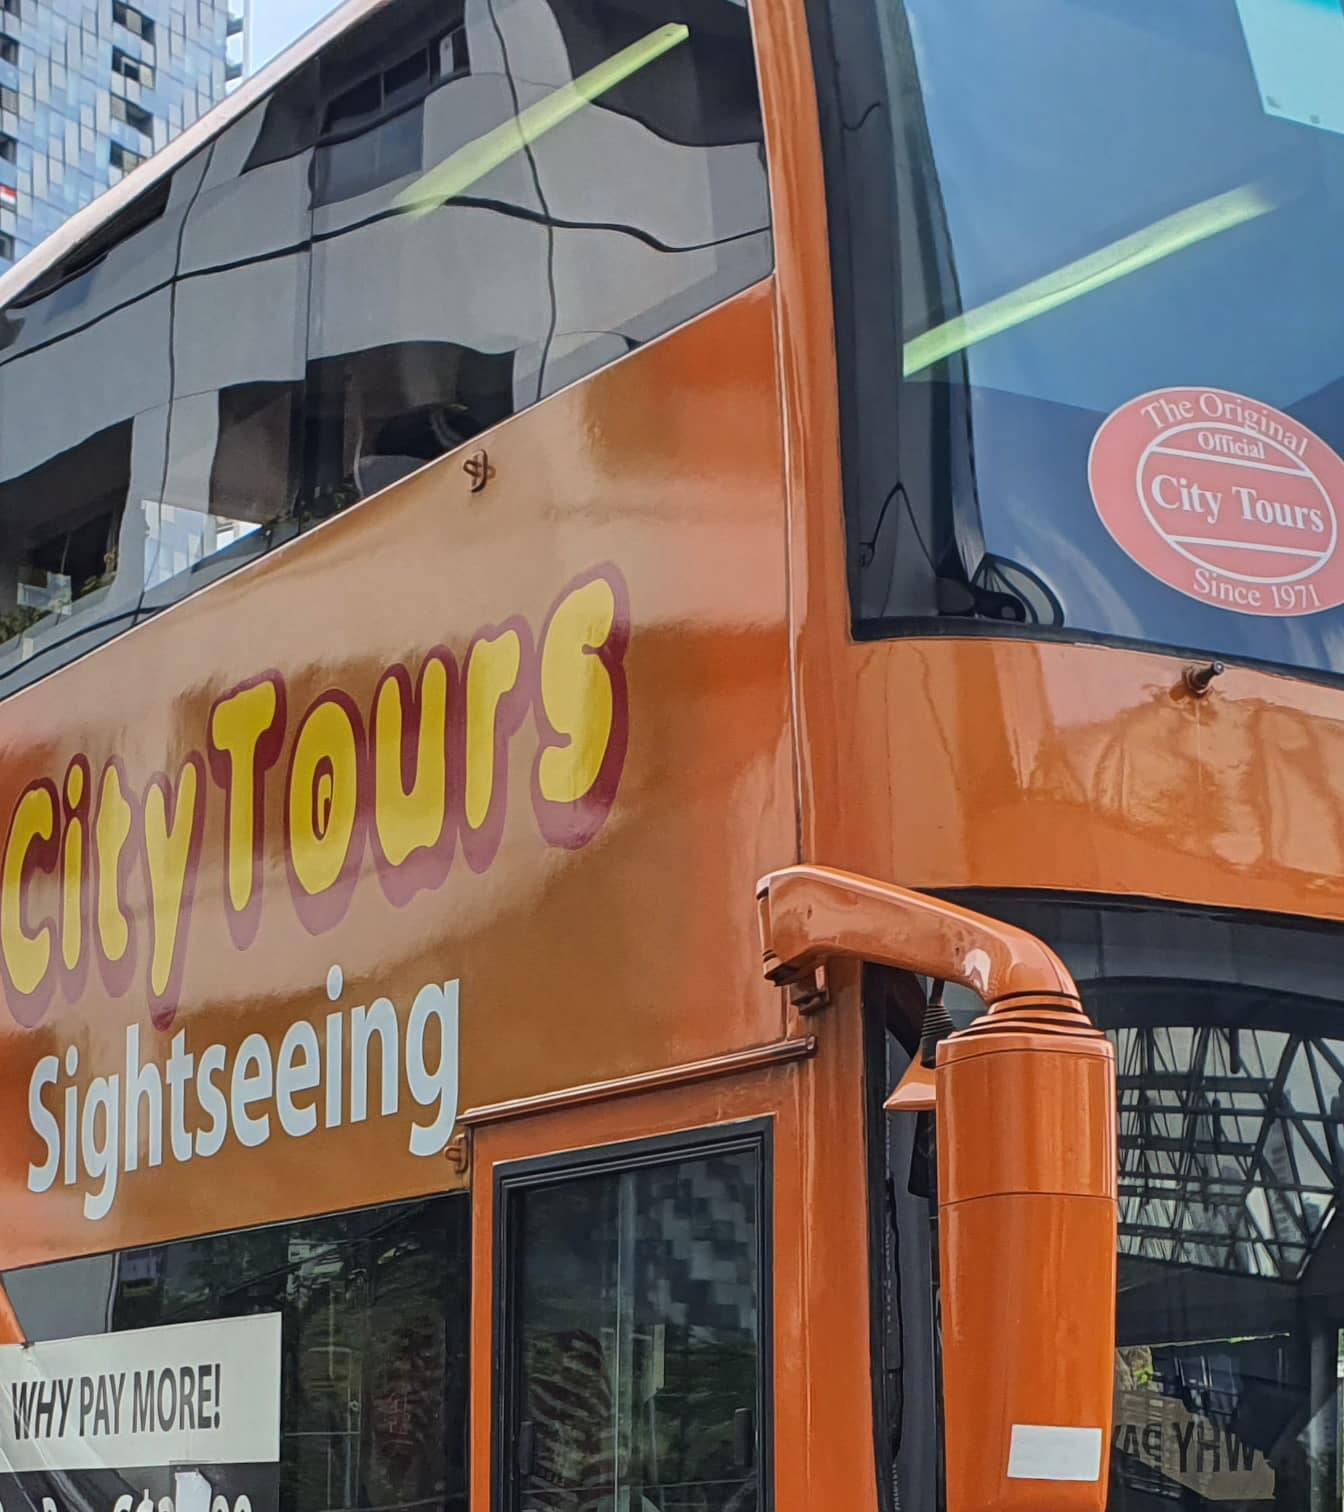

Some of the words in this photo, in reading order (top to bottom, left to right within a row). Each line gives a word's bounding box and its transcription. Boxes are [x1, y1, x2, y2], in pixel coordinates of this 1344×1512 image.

[1141, 398, 1194, 430] The
[1200, 393, 1309, 457] Original
[1198, 432, 1265, 459] Official
[1151, 475, 1222, 524] City
[1232, 486, 1325, 533] Tours
[1193, 568, 1261, 607] Since
[1271, 583, 1322, 609] 1971
[26, 963, 461, 1221] Sightseeing
[11, 1378, 73, 1440] WHY
[79, 1372, 126, 1437] PAY
[132, 1363, 221, 1434] MORE!
